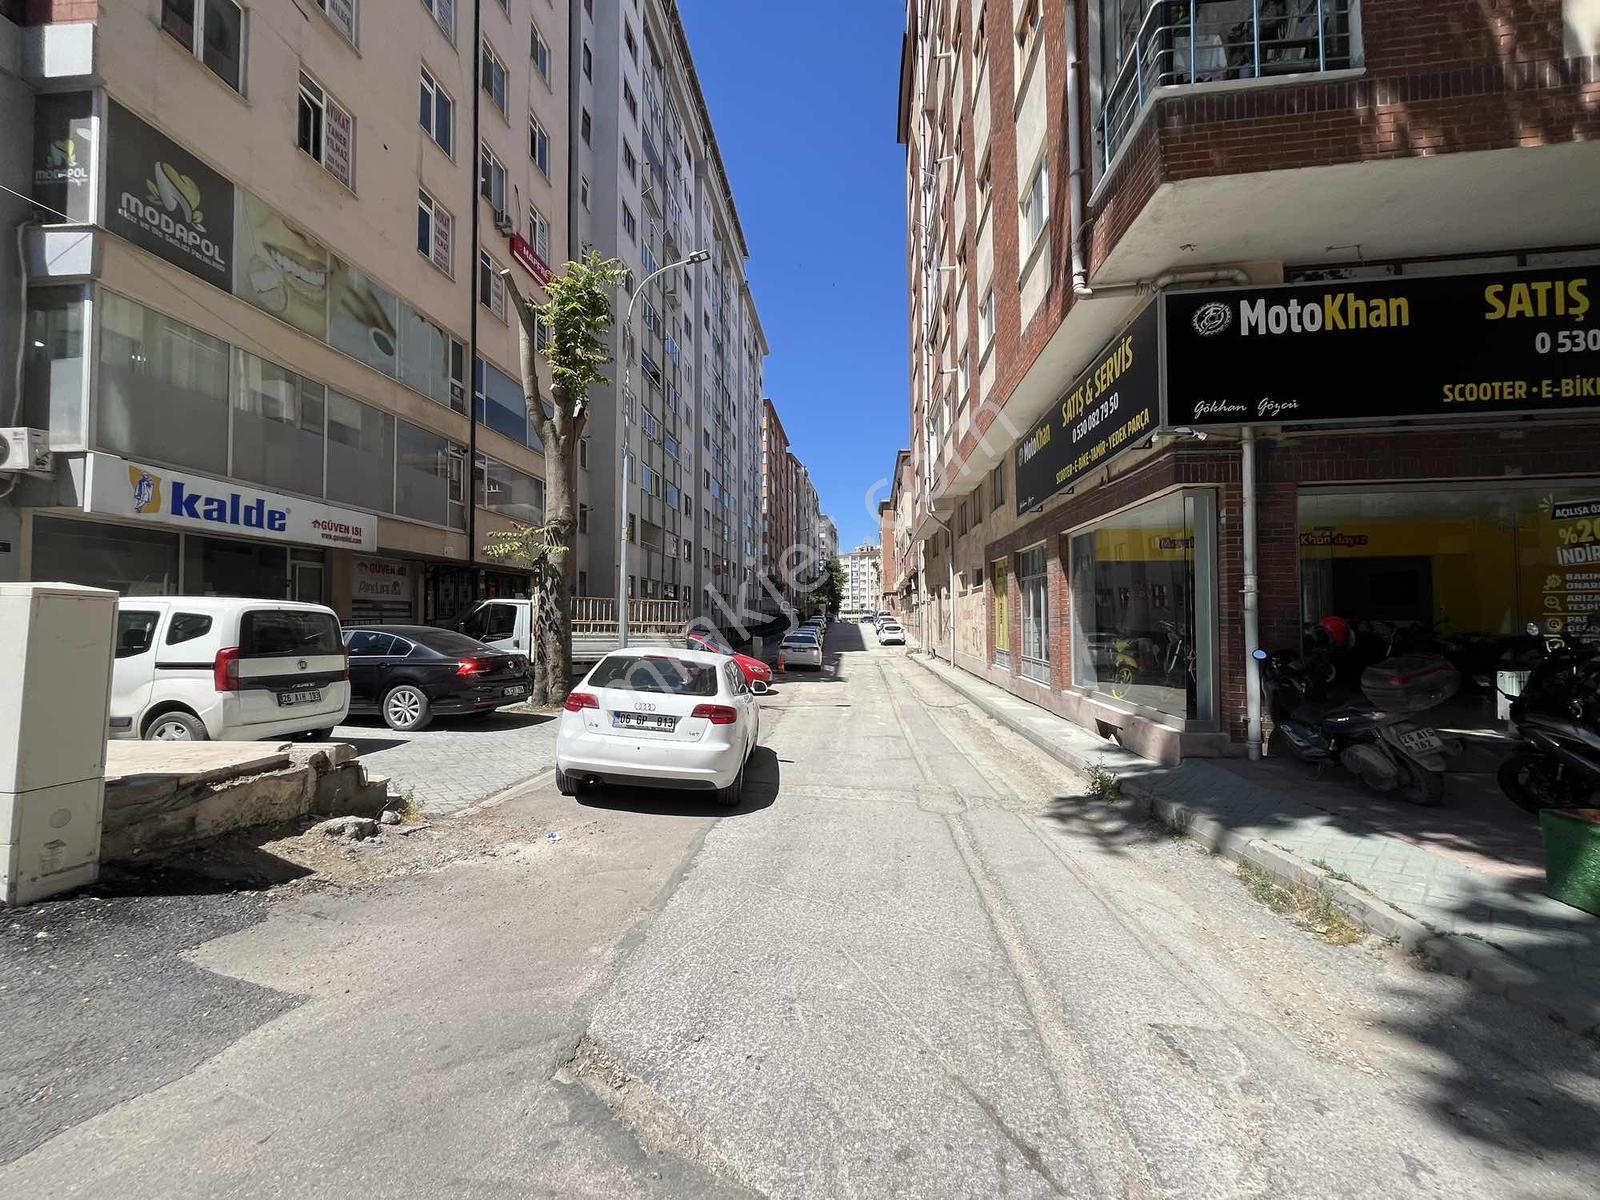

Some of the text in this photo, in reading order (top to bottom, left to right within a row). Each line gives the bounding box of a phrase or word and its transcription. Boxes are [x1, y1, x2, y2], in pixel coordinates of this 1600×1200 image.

[1239, 292, 1410, 336] MotoKhan
[1484, 279, 1590, 321] SATIŞ
[1535, 329, 1600, 354] 0 530
[1062, 335, 1133, 427] SATIŞ & SERVİS
[1443, 380, 1527, 402] SCOOTER
[1077, 420, 1088, 440] 530
[1109, 392, 1119, 414] 50
[1127, 408, 1150, 436] PARÇA
[1194, 398, 1299, 419] Gökhan Gözcü
[171, 481, 287, 532] kalde
[321, 520, 349, 534] GÜVEN
[620, 714, 631, 724] 06
[657, 716, 673, 728] 813
